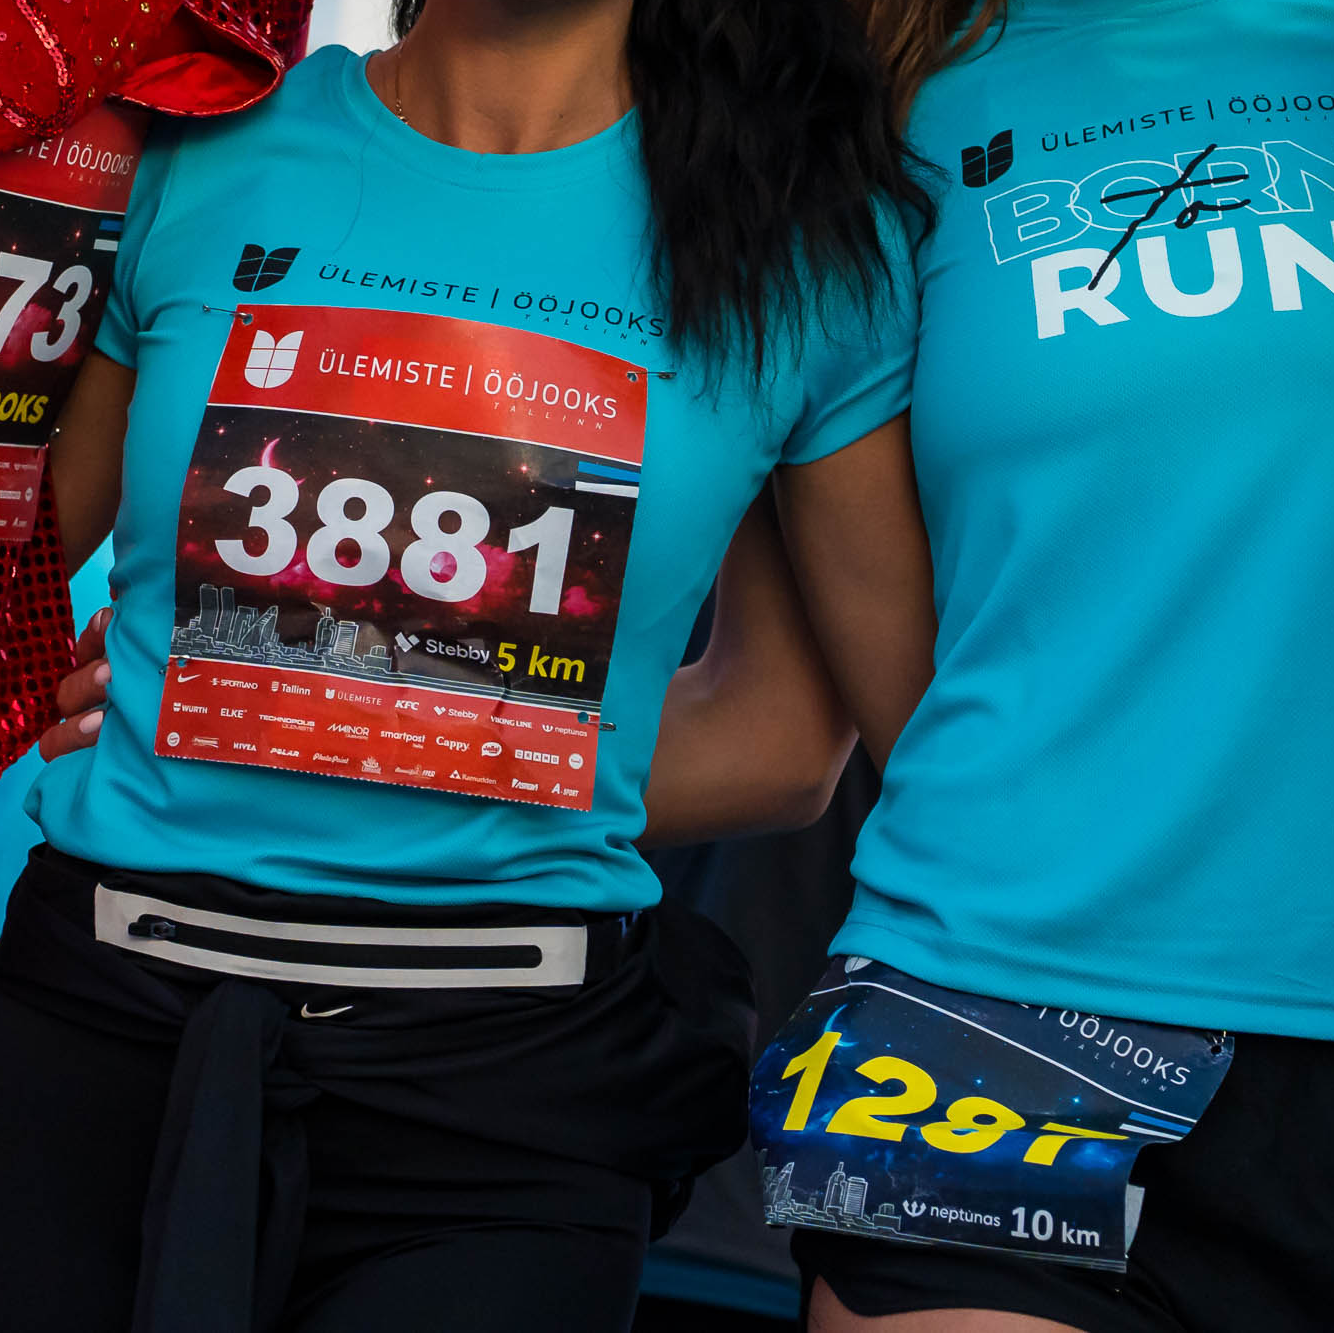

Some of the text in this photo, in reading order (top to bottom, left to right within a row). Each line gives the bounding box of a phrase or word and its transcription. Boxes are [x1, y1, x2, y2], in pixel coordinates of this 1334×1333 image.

[1041, 105, 1196, 152] ÜLEMISTE
[67, 140, 135, 176] ÖÖJOOKS
[318, 263, 666, 337] ÜLEMISTE ÖÖJOOKS
[525, 314, 649, 346] TALLINN
[318, 347, 618, 419] ÜLEMISTE ÖÖJOOKS
[493, 401, 604, 430] TALLINN
[213, 465, 575, 616] 3881
[425, 638, 586, 683] Stebby 5 km
[281, 682, 311, 696] Tallinn
[394, 699, 420, 712] KFC
[448, 708, 479, 721] Stebby
[490, 715, 514, 727] VIKING
[515, 719, 532, 729] LINE
[220, 707, 244, 719] ELKE
[326, 722, 370, 736] MAINOR
[380, 729, 426, 744] smartpost
[435, 735, 470, 752] Cappy
[233, 741, 257, 752] NIVEA
[269, 747, 300, 758] POLAR
[1062, 1033, 1168, 1092] TALLINN
[1010, 1206, 1055, 1242] 10
[1061, 1220, 1101, 1248] km
